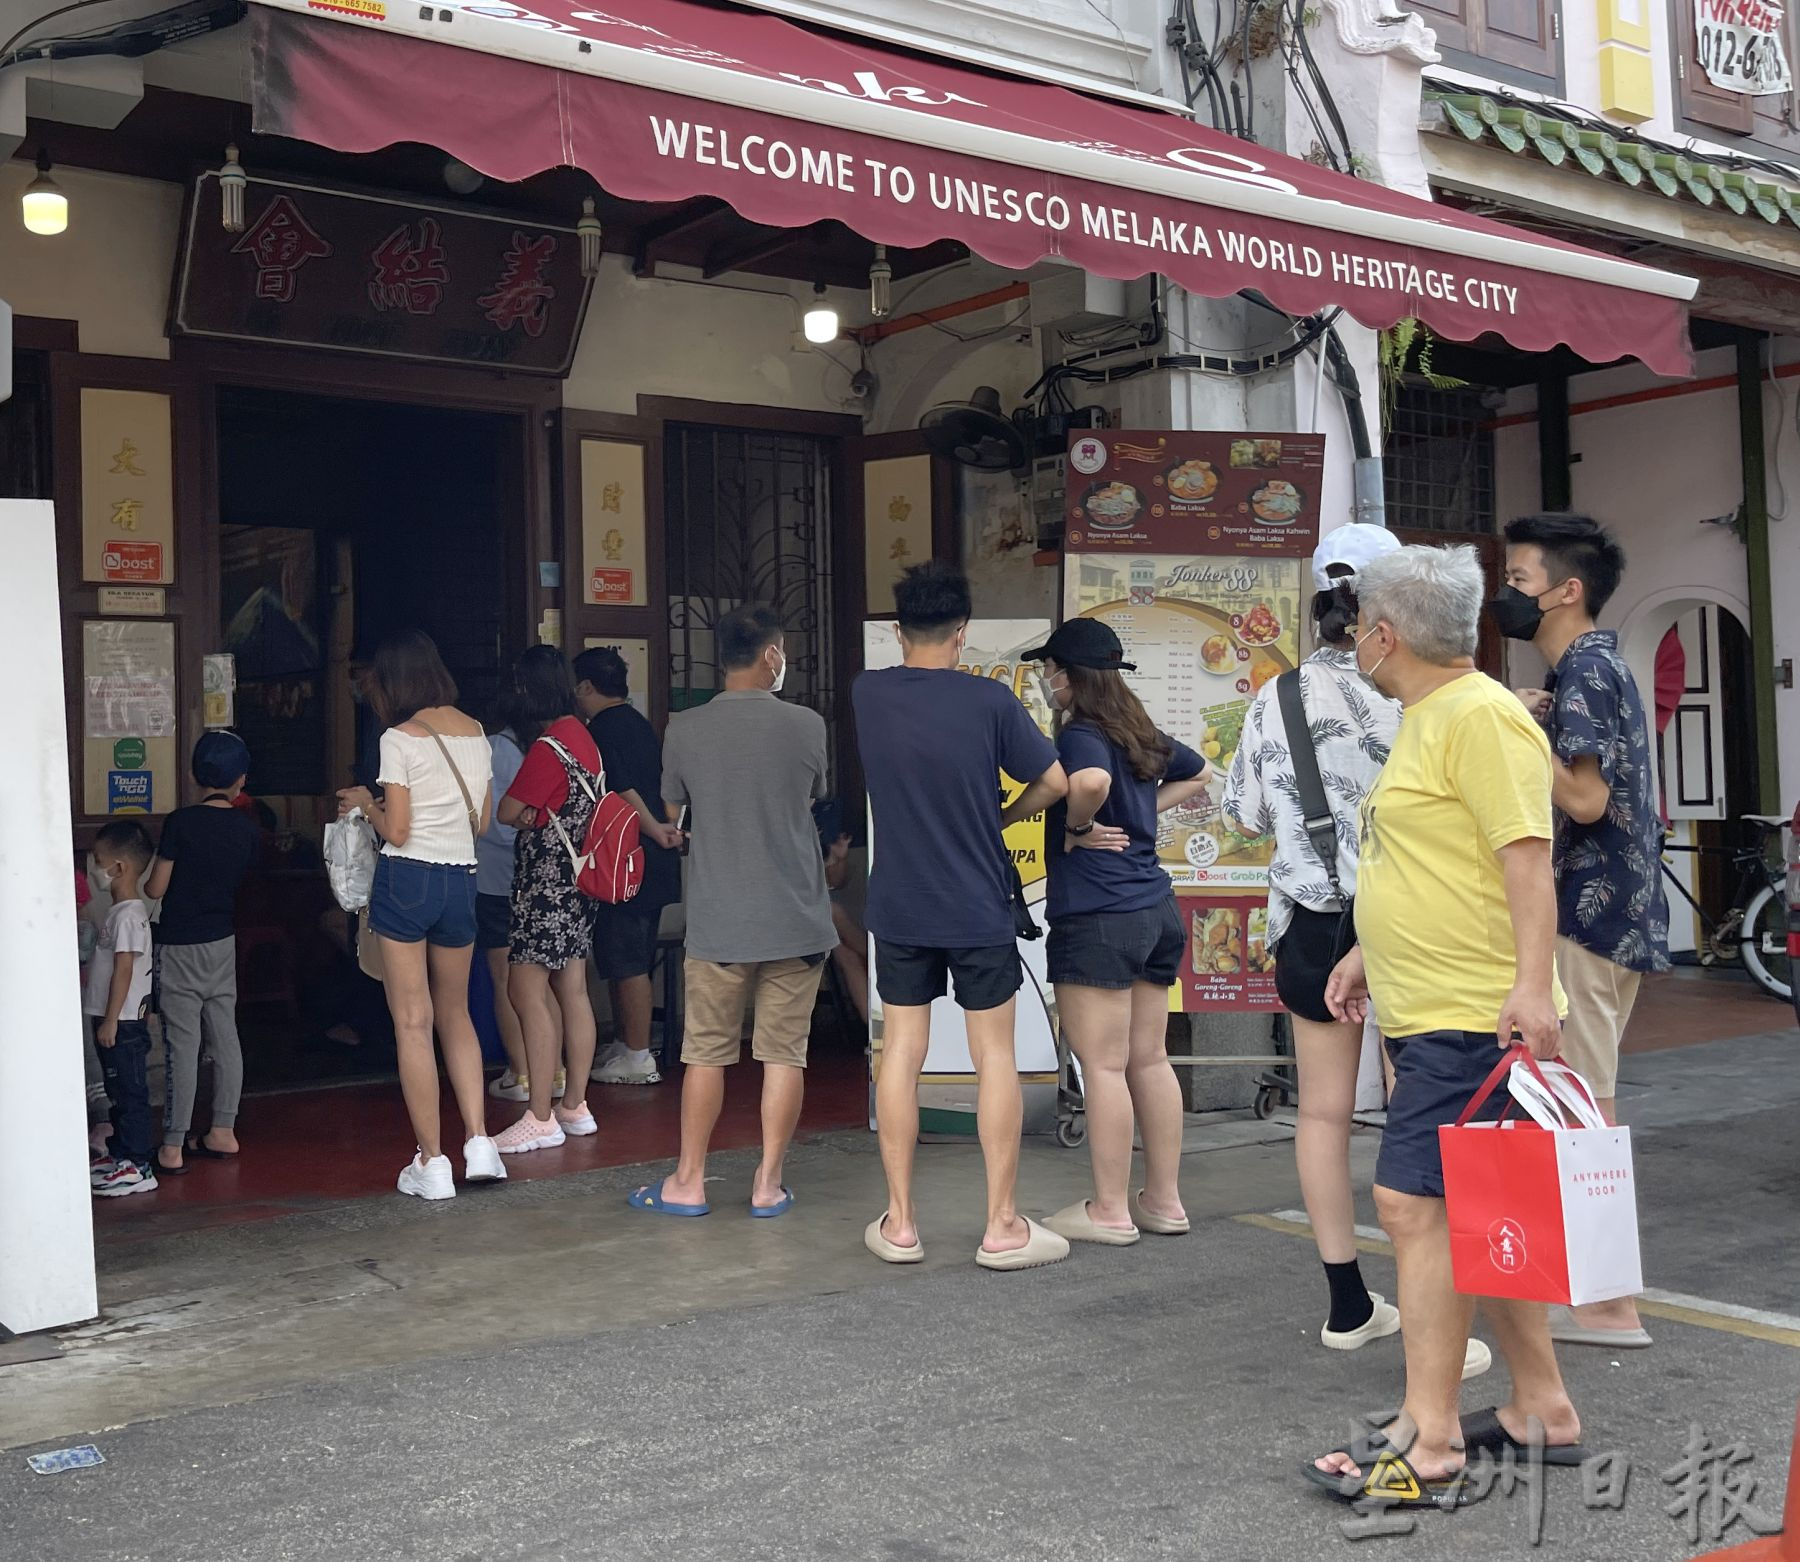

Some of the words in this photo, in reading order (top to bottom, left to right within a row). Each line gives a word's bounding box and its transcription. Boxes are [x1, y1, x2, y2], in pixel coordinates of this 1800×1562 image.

[362, 1, 382, 12] 7582
[649, 115, 855, 193] WELCOME
[865, 159, 915, 203] TO
[929, 172, 1070, 230] UNESCO
[1081, 202, 1213, 258] MELAKA
[1217, 229, 1322, 278] WORLD
[1331, 251, 1458, 303] HERITAGE
[1464, 277, 1518, 315] CITY
[1223, 526, 1247, 535] Nyonya
[113, 775, 148, 785] Touch
[1573, 1168, 1627, 1183] ANYWHERE
[1587, 1185, 1616, 1197] DOOR
